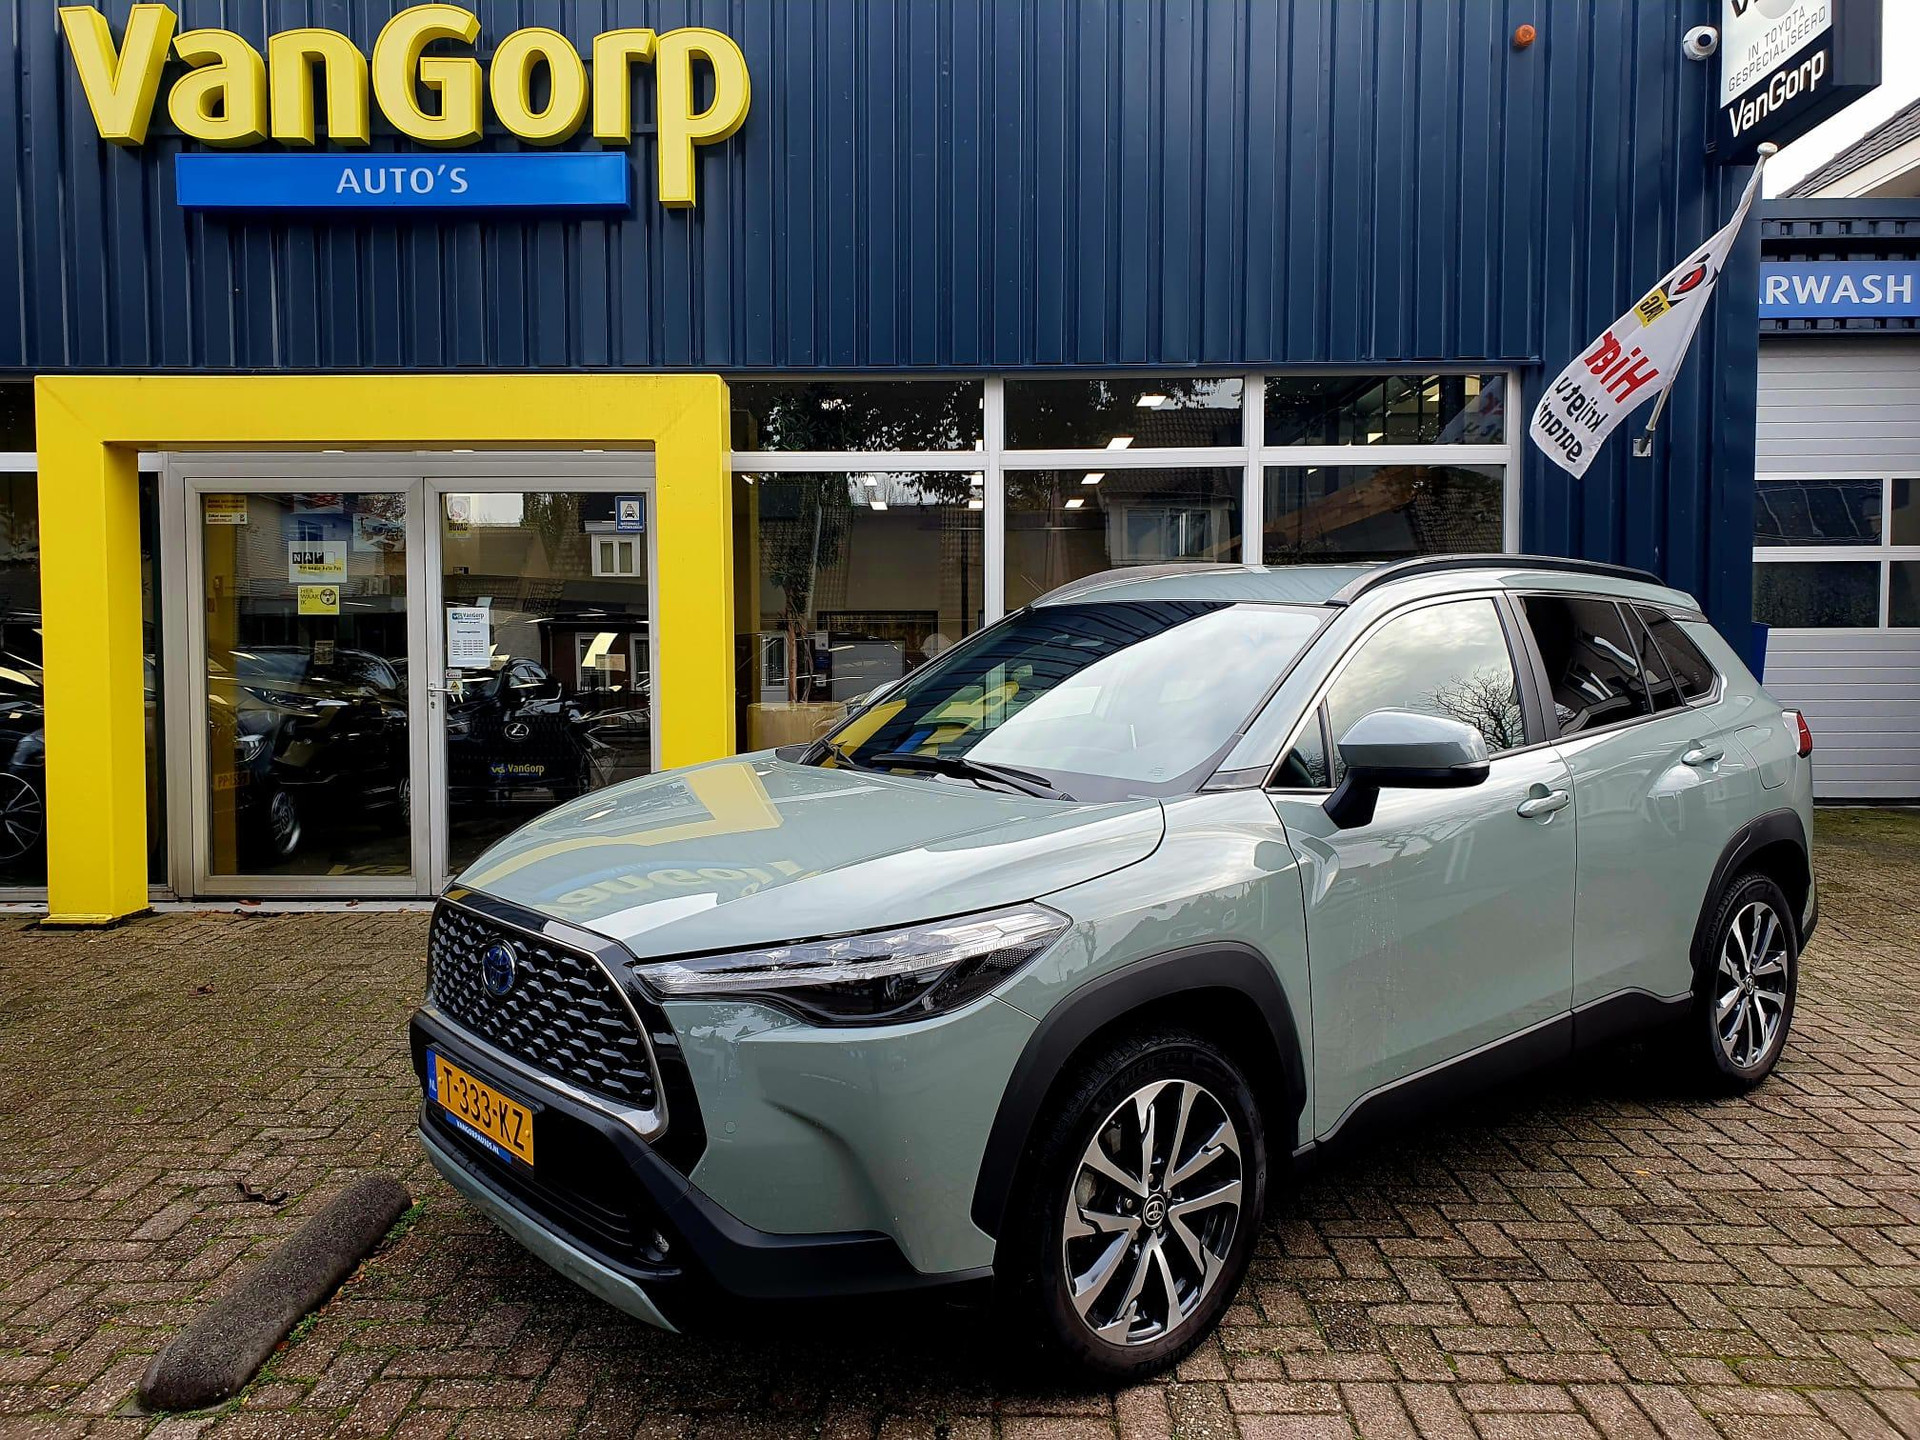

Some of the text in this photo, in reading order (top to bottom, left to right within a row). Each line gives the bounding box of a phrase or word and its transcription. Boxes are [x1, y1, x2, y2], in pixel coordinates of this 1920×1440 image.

[1728, 5, 1826, 92] GESPECIALISEERD
[1748, 42, 1759, 61] IN
[1765, 5, 1806, 47] TOYOTA
[60, 3, 750, 208] VanGorp
[1729, 50, 1826, 138] VanGorp
[336, 164, 469, 195] AUTO'S
[1760, 274, 1912, 304] RWASH
[507, 763, 545, 776] VanGorp
[443, 1066, 525, 1152] T-333-KZ
